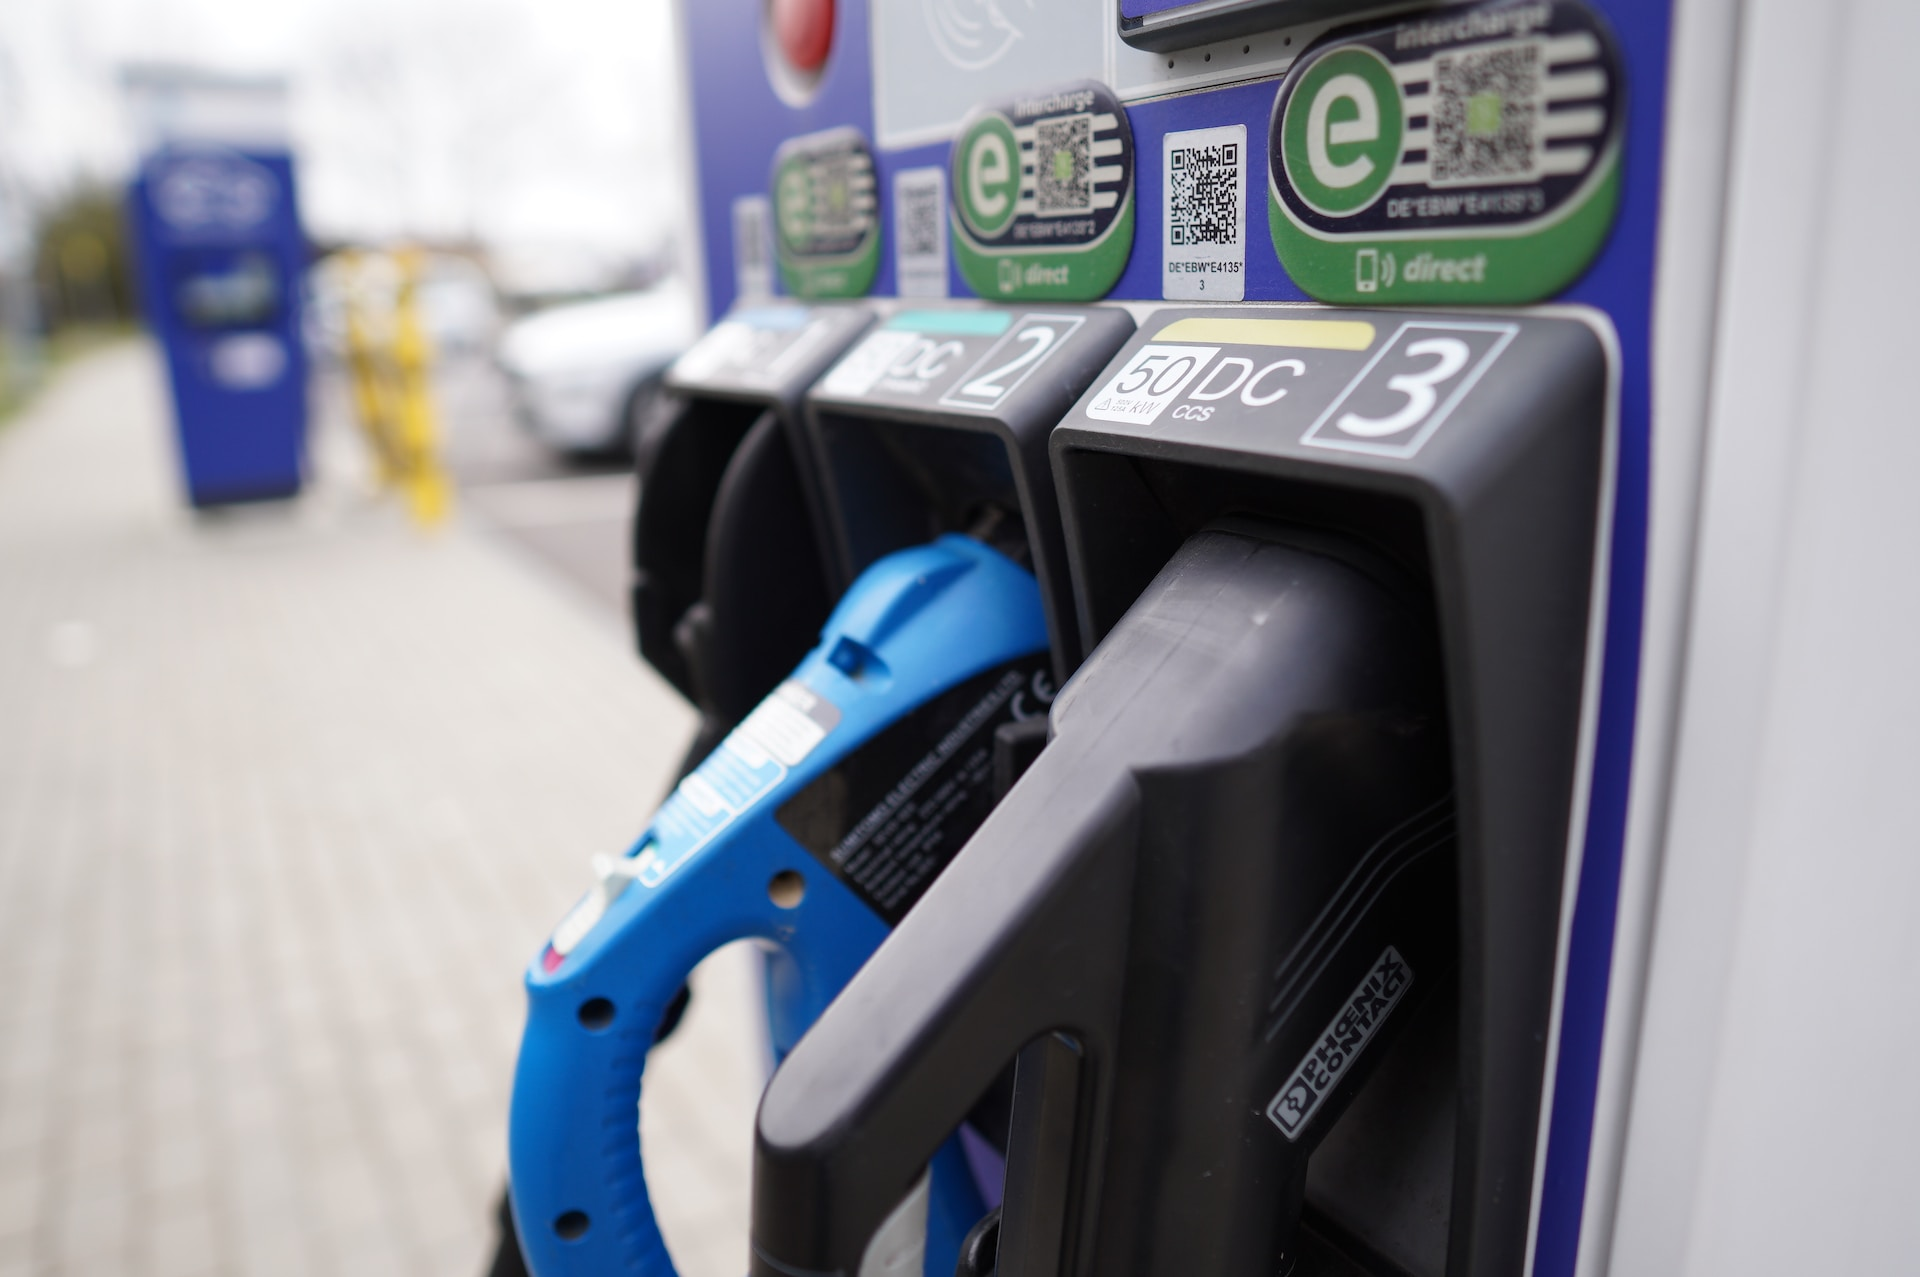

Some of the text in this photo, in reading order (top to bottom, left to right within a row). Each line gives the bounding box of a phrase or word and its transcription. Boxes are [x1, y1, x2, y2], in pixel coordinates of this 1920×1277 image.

[1307, 74, 1380, 189] e
[968, 132, 1011, 216] e
[1024, 264, 1070, 286] direct
[1199, 279, 1205, 291] 3
[1403, 253, 1486, 282] direct
[889, 337, 965, 379] DC
[960, 326, 1055, 397] 2
[1116, 355, 1197, 397] 50
[1188, 356, 1306, 407] DC
[1335, 337, 1470, 437] 3
[1129, 400, 1161, 415] kW
[1172, 404, 1216, 421] CCS
[1314, 969, 1405, 1092] CONTACT
